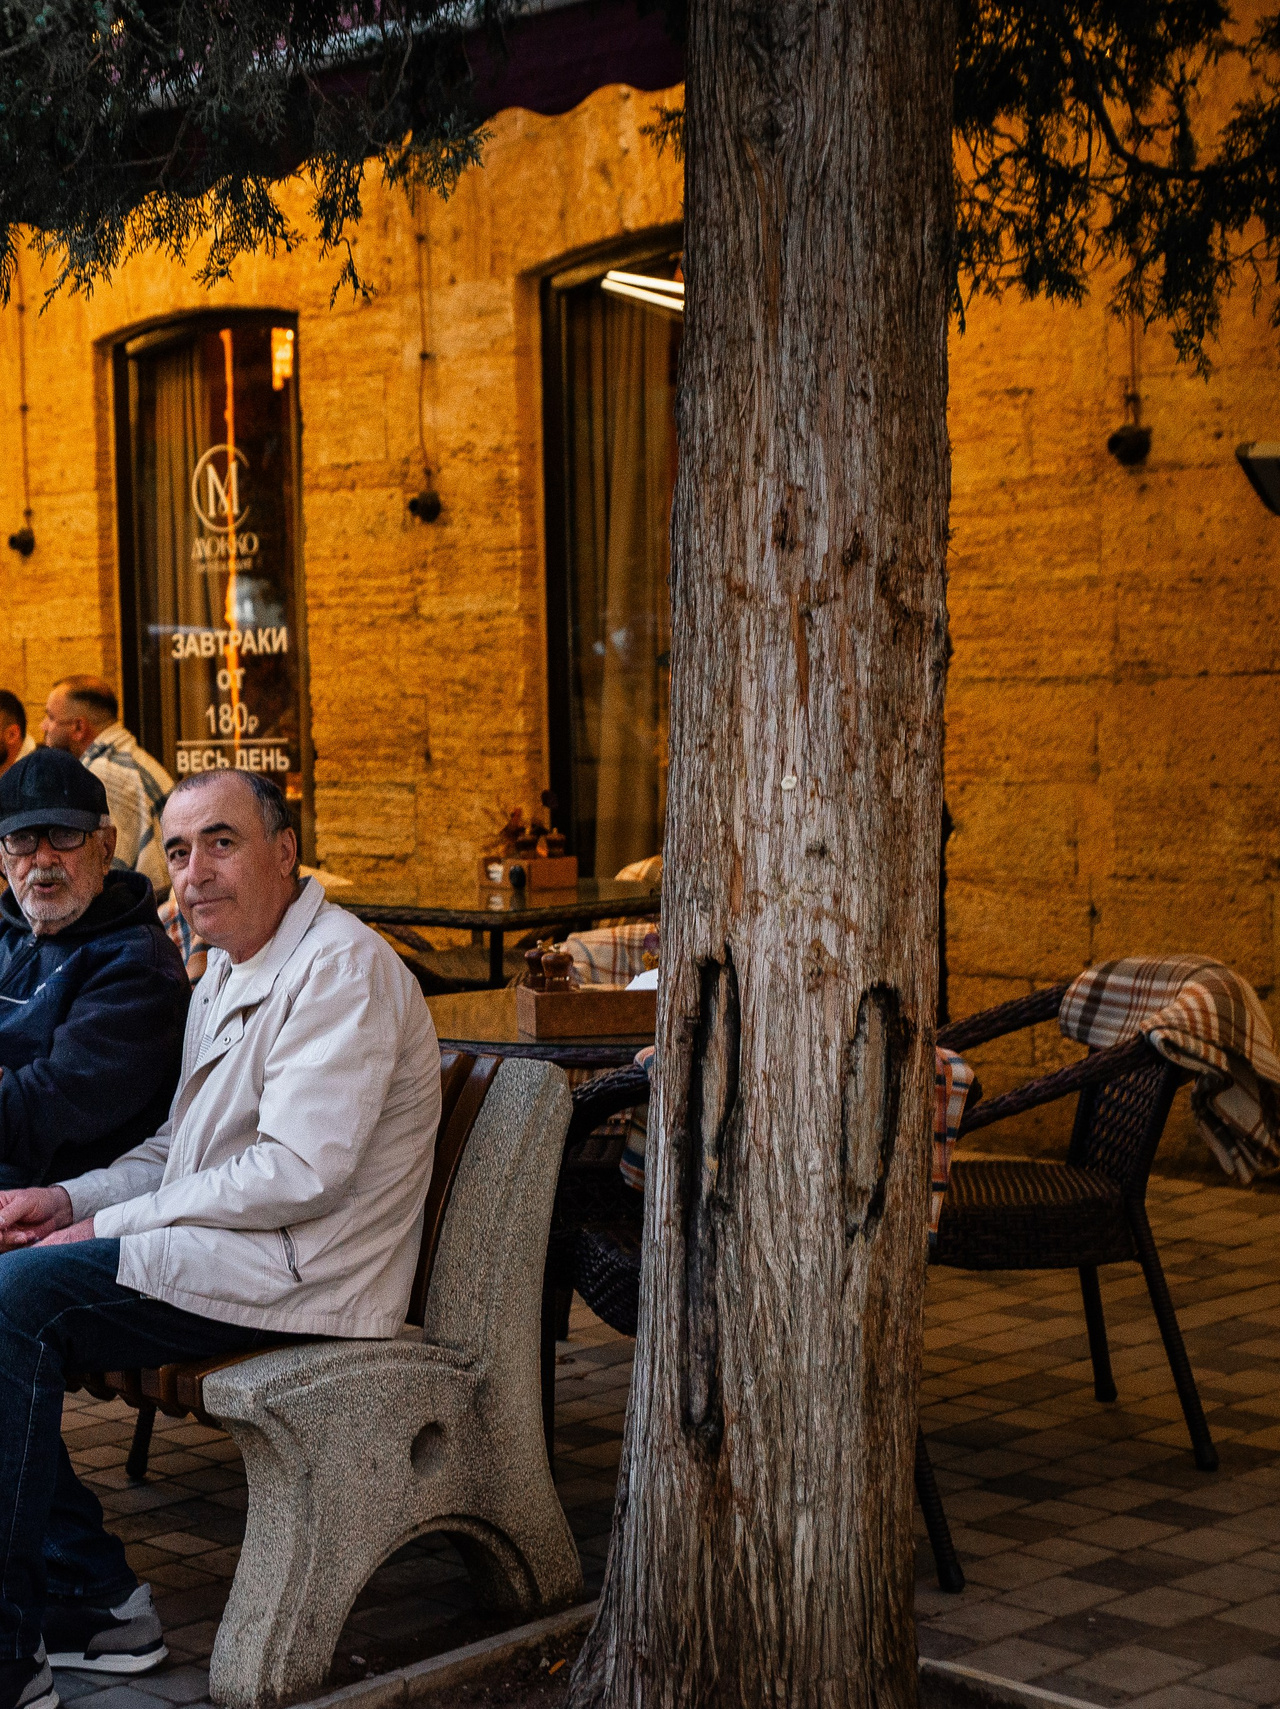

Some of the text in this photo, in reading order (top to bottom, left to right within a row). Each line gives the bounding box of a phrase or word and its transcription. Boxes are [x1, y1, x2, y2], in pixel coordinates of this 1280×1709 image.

[171, 626, 288, 659] ЗАВТРАКИ
[176, 748, 290, 773] ВЕСЬ ДЕНЬ
